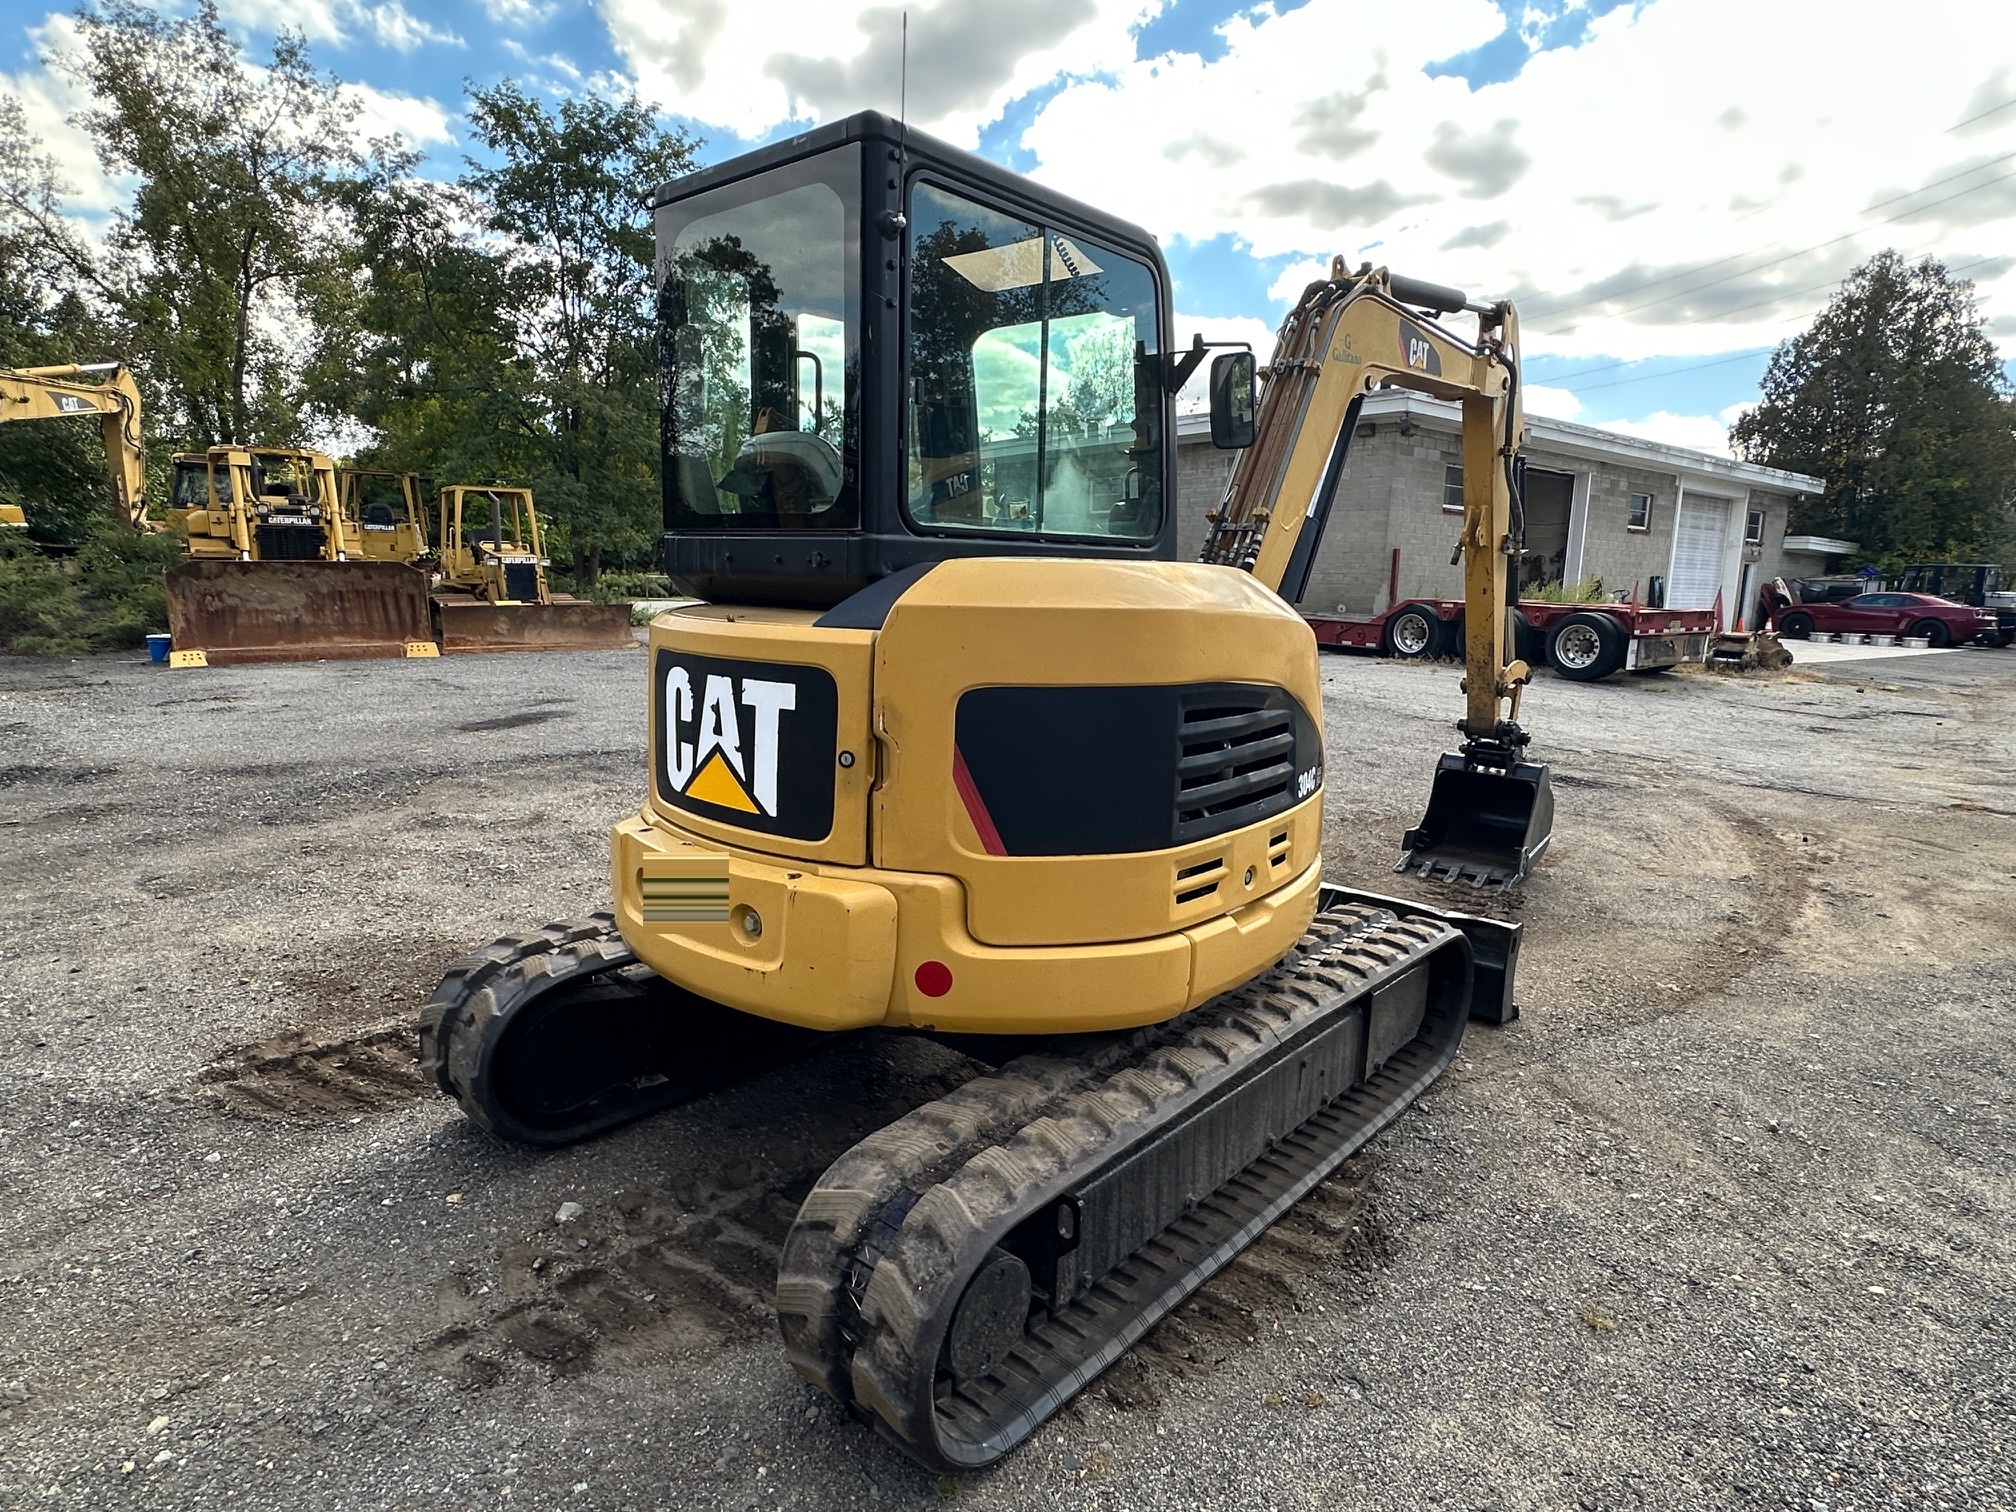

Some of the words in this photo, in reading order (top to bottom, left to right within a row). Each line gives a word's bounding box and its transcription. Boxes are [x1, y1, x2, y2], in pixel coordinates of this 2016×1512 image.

[1410, 337, 1429, 370] CAT
[62, 397, 79, 411] CAT
[268, 517, 312, 525] CATERPILLAR
[666, 666, 796, 817] CAT
